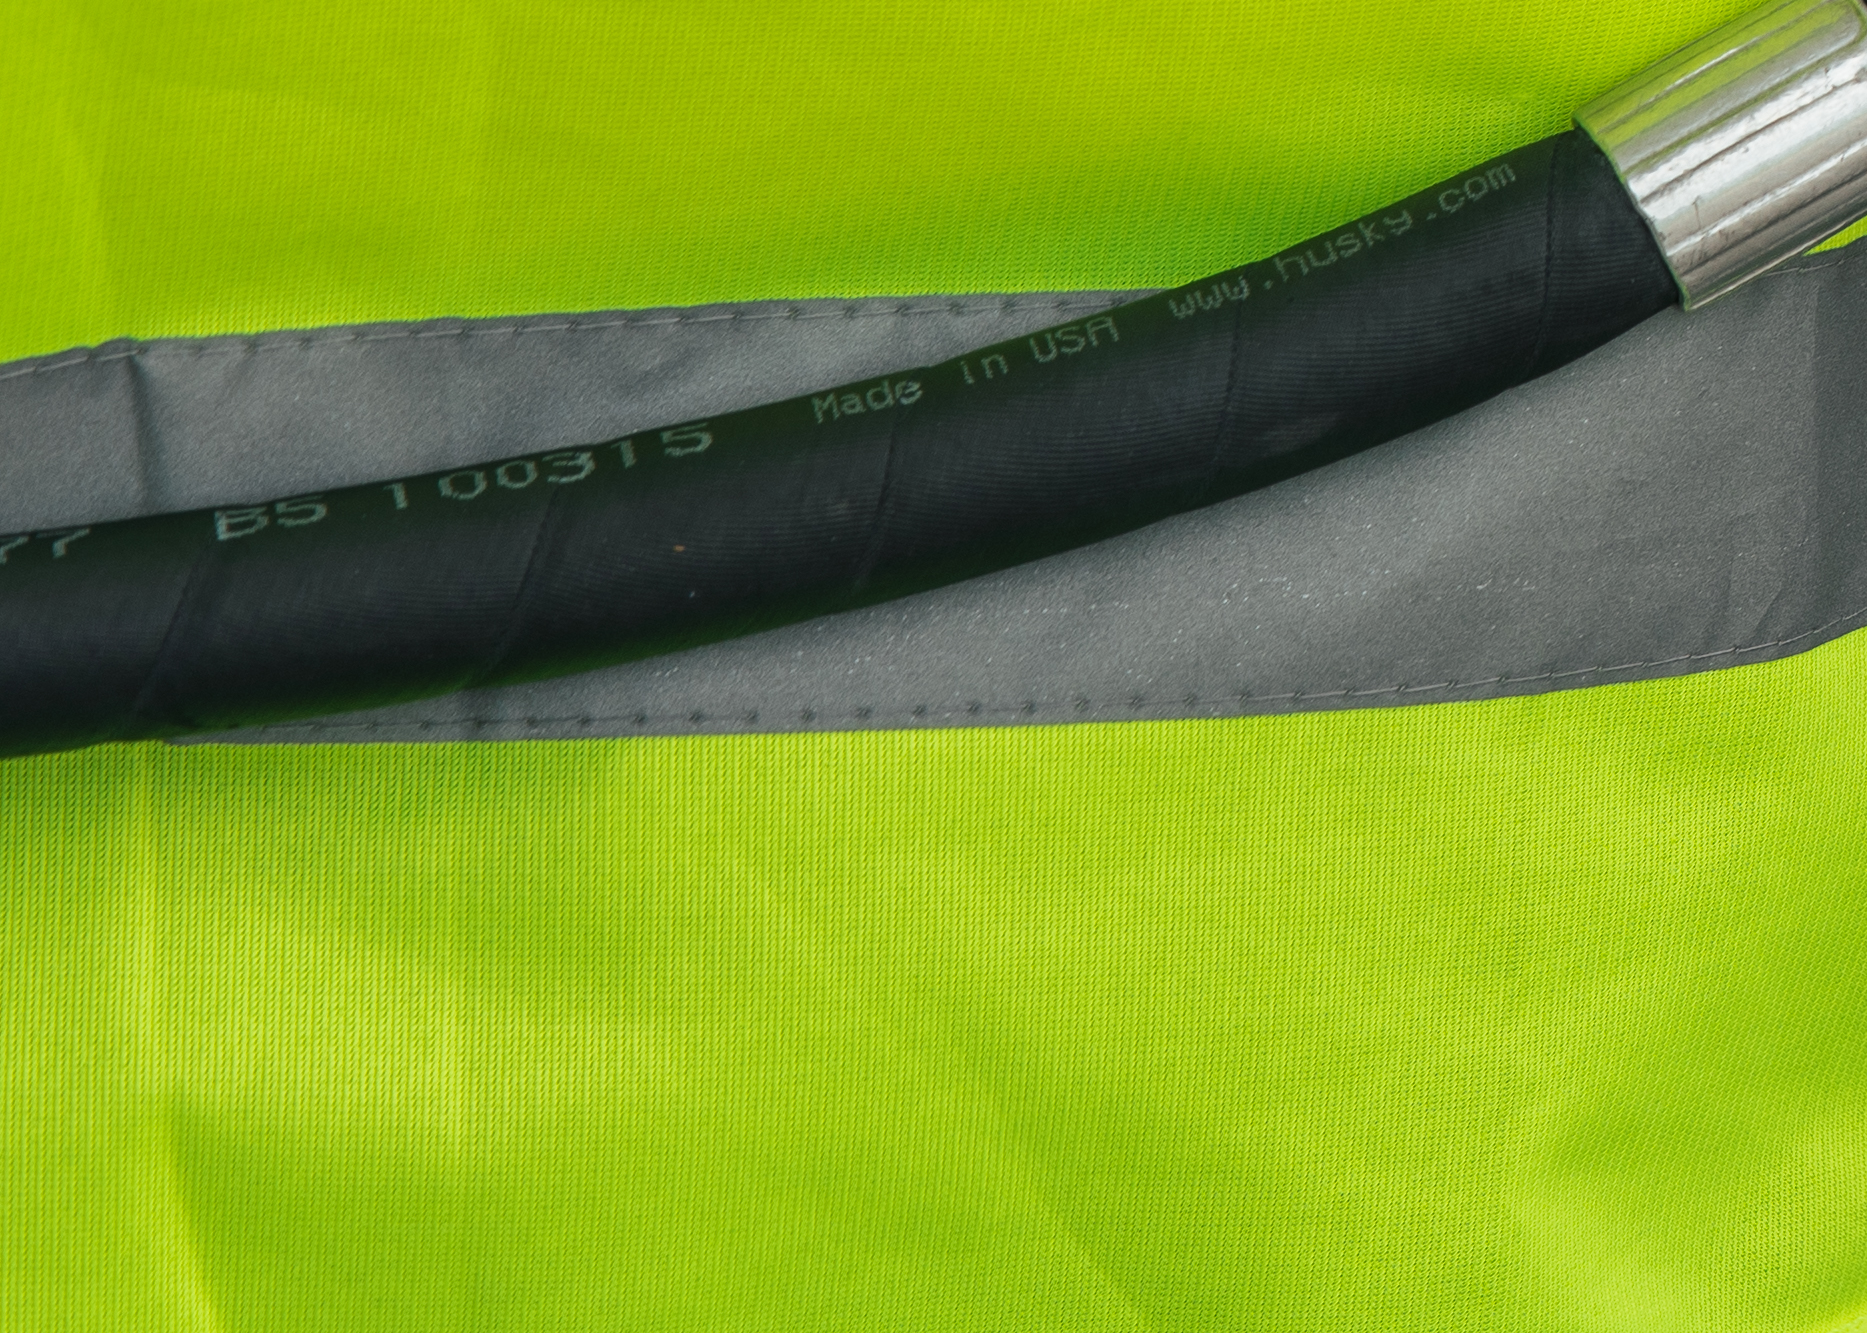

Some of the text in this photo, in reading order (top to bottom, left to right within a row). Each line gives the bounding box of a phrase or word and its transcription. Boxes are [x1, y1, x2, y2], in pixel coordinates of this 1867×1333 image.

[381, 421, 713, 509] 100315
[811, 379, 924, 424] Made
[959, 353, 1010, 384] in
[1030, 316, 1120, 363] USA
[1168, 162, 1517, 321] www.husky.com
